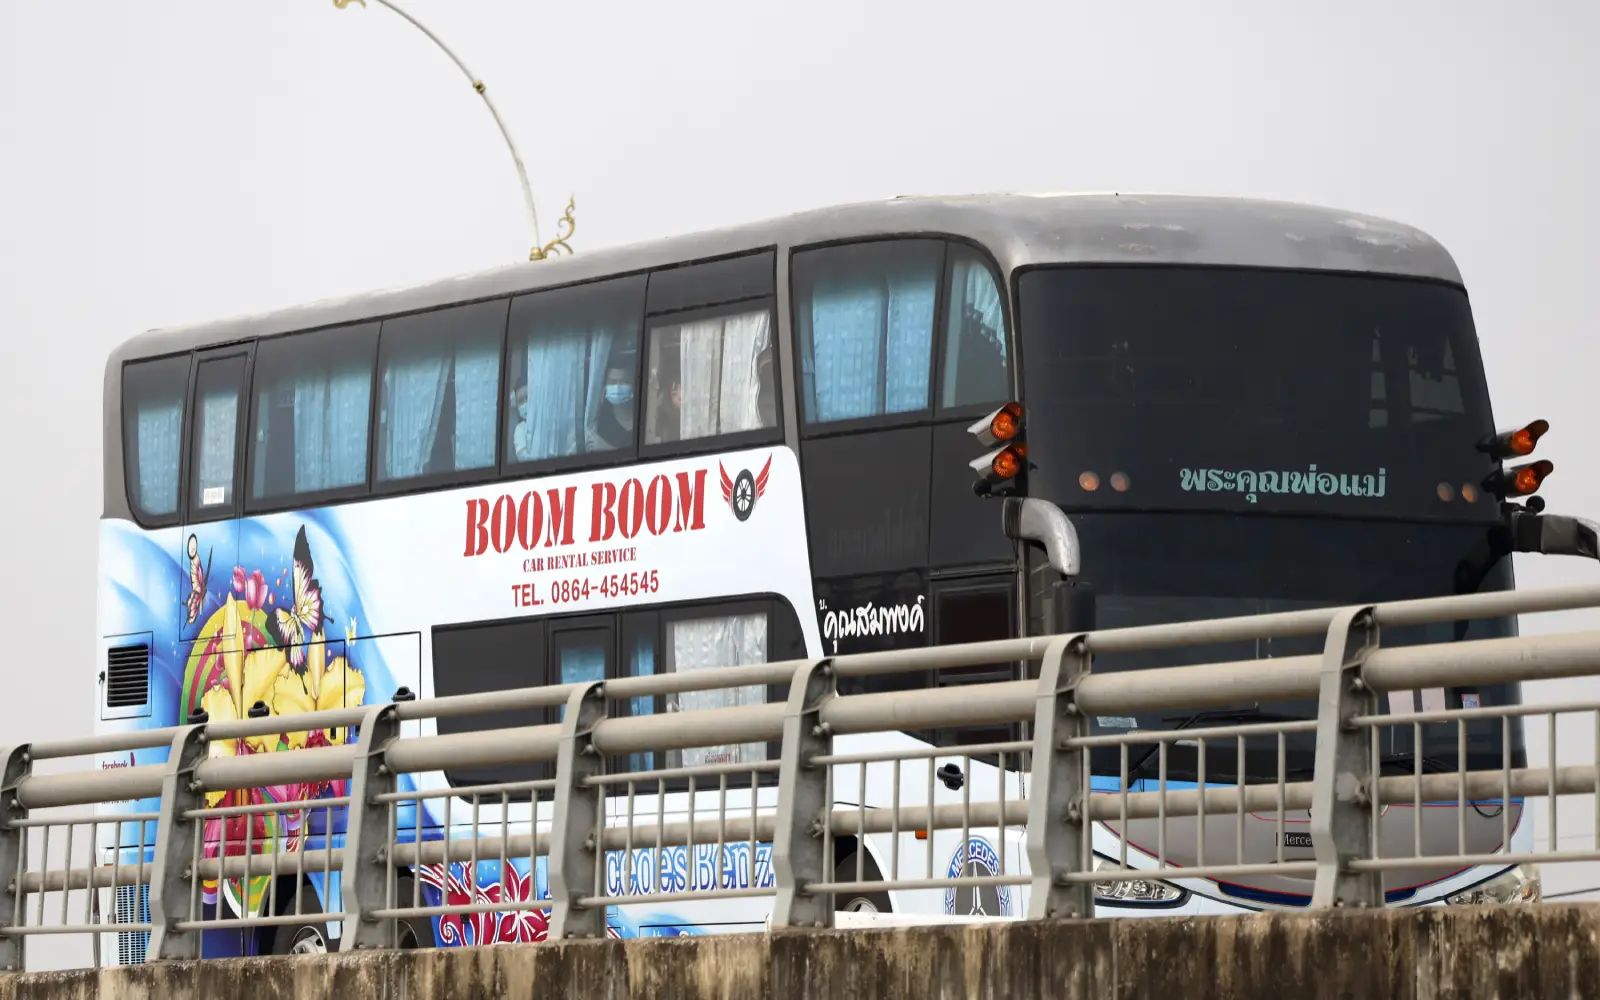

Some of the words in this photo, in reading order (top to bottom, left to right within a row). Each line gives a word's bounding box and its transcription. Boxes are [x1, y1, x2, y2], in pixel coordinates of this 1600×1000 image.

[1179, 464, 1386, 503] พระคุณพ่อแม่
[463, 486, 578, 557] BOOM
[588, 469, 708, 543] BOOM
[523, 557, 545, 573] CAR
[547, 552, 589, 571] RENTAL
[590, 546, 637, 566] SERVICE
[511, 583, 545, 607] TEL.
[551, 569, 659, 603] 0864-454545
[951, 841, 999, 878] MECEDES
